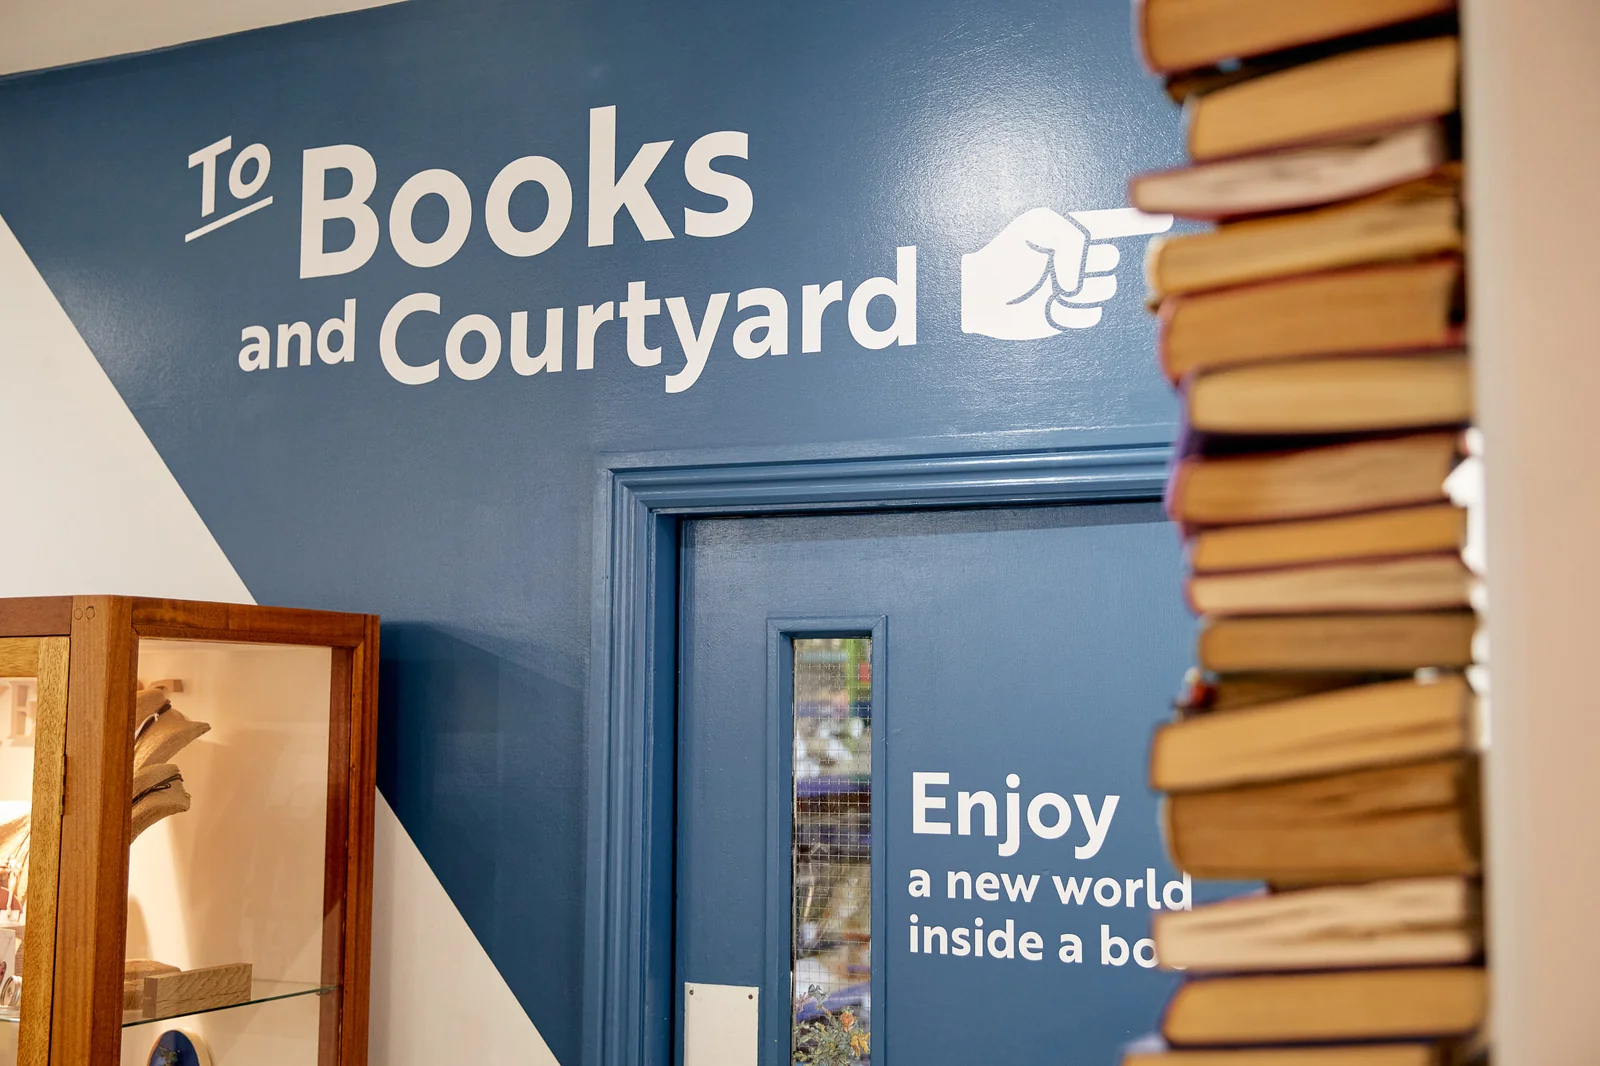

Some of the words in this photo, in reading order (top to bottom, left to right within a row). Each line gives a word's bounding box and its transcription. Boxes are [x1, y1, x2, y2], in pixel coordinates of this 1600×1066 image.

[299, 105, 754, 279] Books
[238, 298, 356, 372] and
[379, 245, 918, 394] Courtyard
[910, 772, 1120, 860] Enjoy
[907, 869, 932, 899] a
[947, 870, 1041, 903] new
[1052, 867, 1193, 911] world
[909, 913, 1044, 961] inside
[1057, 933, 1084, 963] a
[1100, 924, 1186, 970] bo
